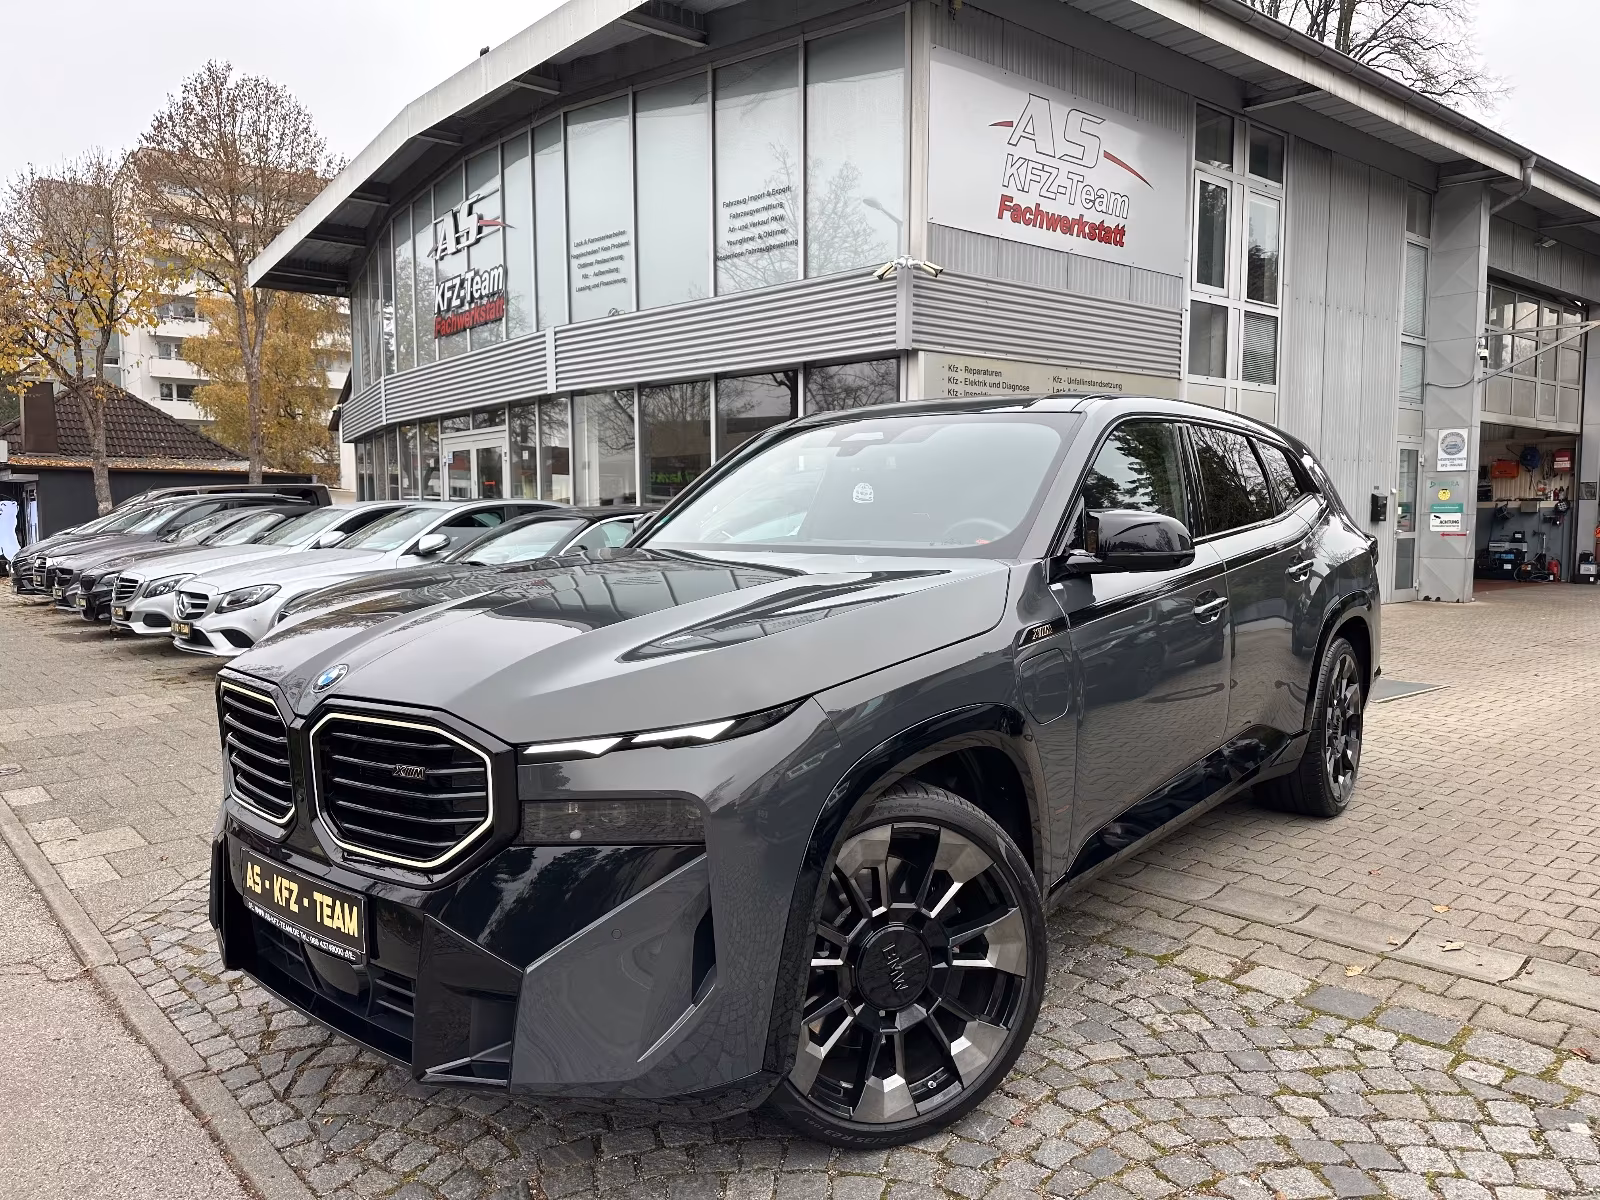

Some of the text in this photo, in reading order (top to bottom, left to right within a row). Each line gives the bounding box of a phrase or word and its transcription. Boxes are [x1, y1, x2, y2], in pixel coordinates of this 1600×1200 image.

[1007, 92, 1106, 169] AS
[723, 197, 747, 209] Fahrzeug
[1002, 153, 1130, 219] KFZ-Team
[435, 194, 481, 260] AS
[997, 193, 1127, 247] Fachwerkstatt
[434, 264, 505, 314] KFZ-Team
[434, 293, 505, 339] Fachwerkstatt
[947, 376, 959, 385] Kfz
[964, 378, 988, 388] Elektrik
[988, 381, 1001, 389] und
[1001, 381, 1030, 392] Diagnose
[947, 388, 959, 397] Kfz
[948, 364, 959, 373] Kfz
[964, 365, 1003, 378] Reparaturen
[1052, 376, 1062, 384] Kfz
[1066, 377, 1123, 392] Unfallinstandsetzung
[246, 861, 262, 894] AS
[273, 873, 299, 913] KFZ
[313, 890, 359, 938] TEAM
